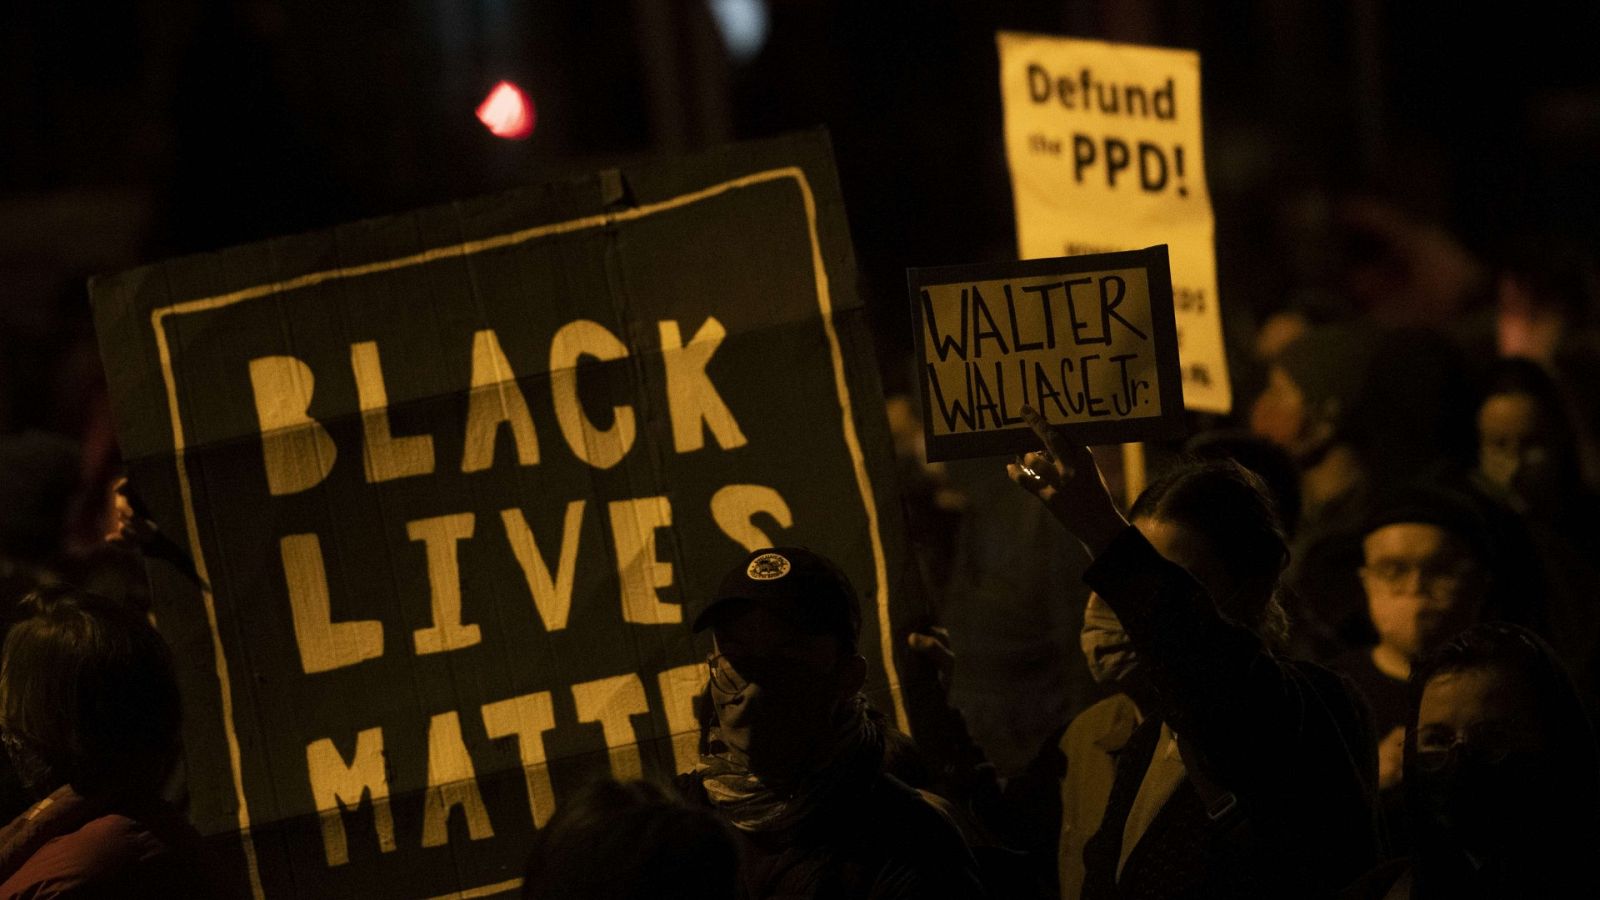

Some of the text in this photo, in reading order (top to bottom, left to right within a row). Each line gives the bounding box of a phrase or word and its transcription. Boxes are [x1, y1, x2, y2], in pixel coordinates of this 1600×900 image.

[1026, 63, 1177, 120] Defund
[1072, 132, 1189, 198] PPD!
[920, 275, 1148, 362] WALTER
[247, 315, 749, 496] BLACK
[1109, 354, 1150, 416] Jr.
[279, 483, 795, 675] LIVES
[305, 662, 712, 868] MATTE
